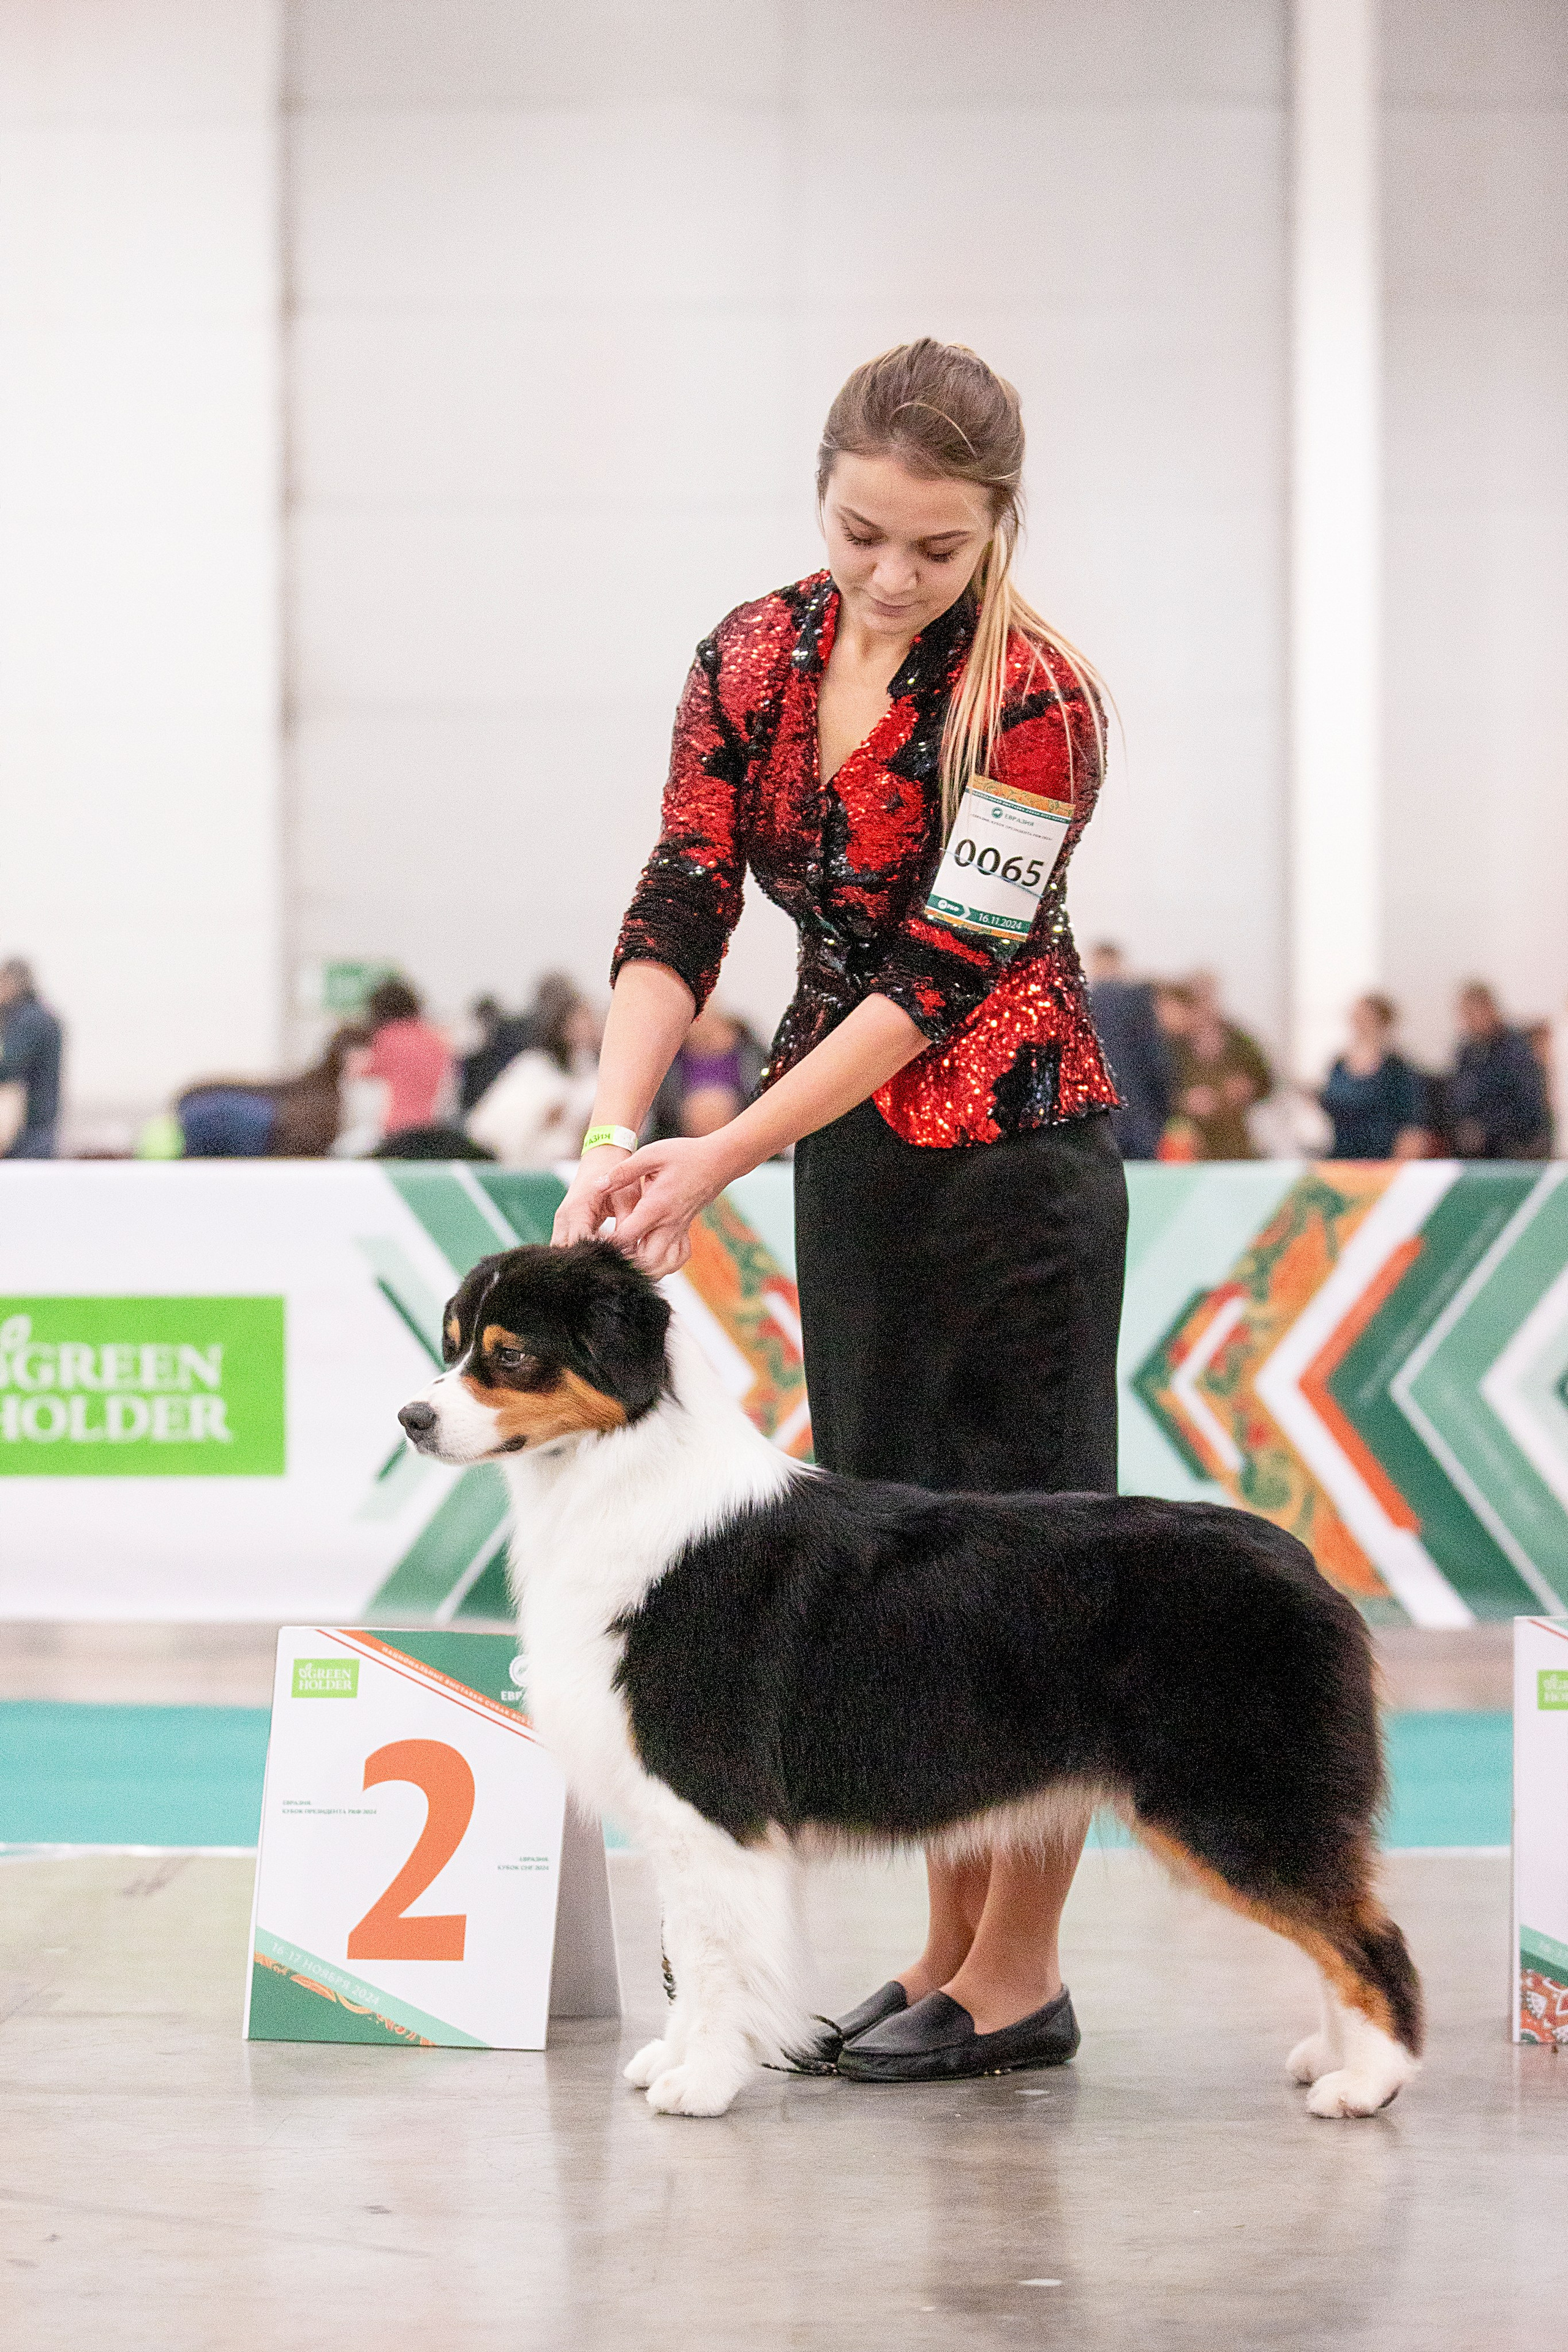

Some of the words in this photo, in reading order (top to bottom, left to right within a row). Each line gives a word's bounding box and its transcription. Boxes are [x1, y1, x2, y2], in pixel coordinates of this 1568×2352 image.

[1004, 813, 1035, 827] ЕВРАЗИЯ
[954, 839, 1044, 887] 0065
[978, 913, 1022, 930] 16.11.2024
[12, 1342, 224, 1392] GREEN
[298, 1680, 352, 1691] HOLDER
[306, 1668, 352, 1679] GREEN
[347, 1738, 476, 1961] 2
[301, 1958, 352, 1991] НОЯБРЯ
[351, 1984, 380, 2006] 2024
